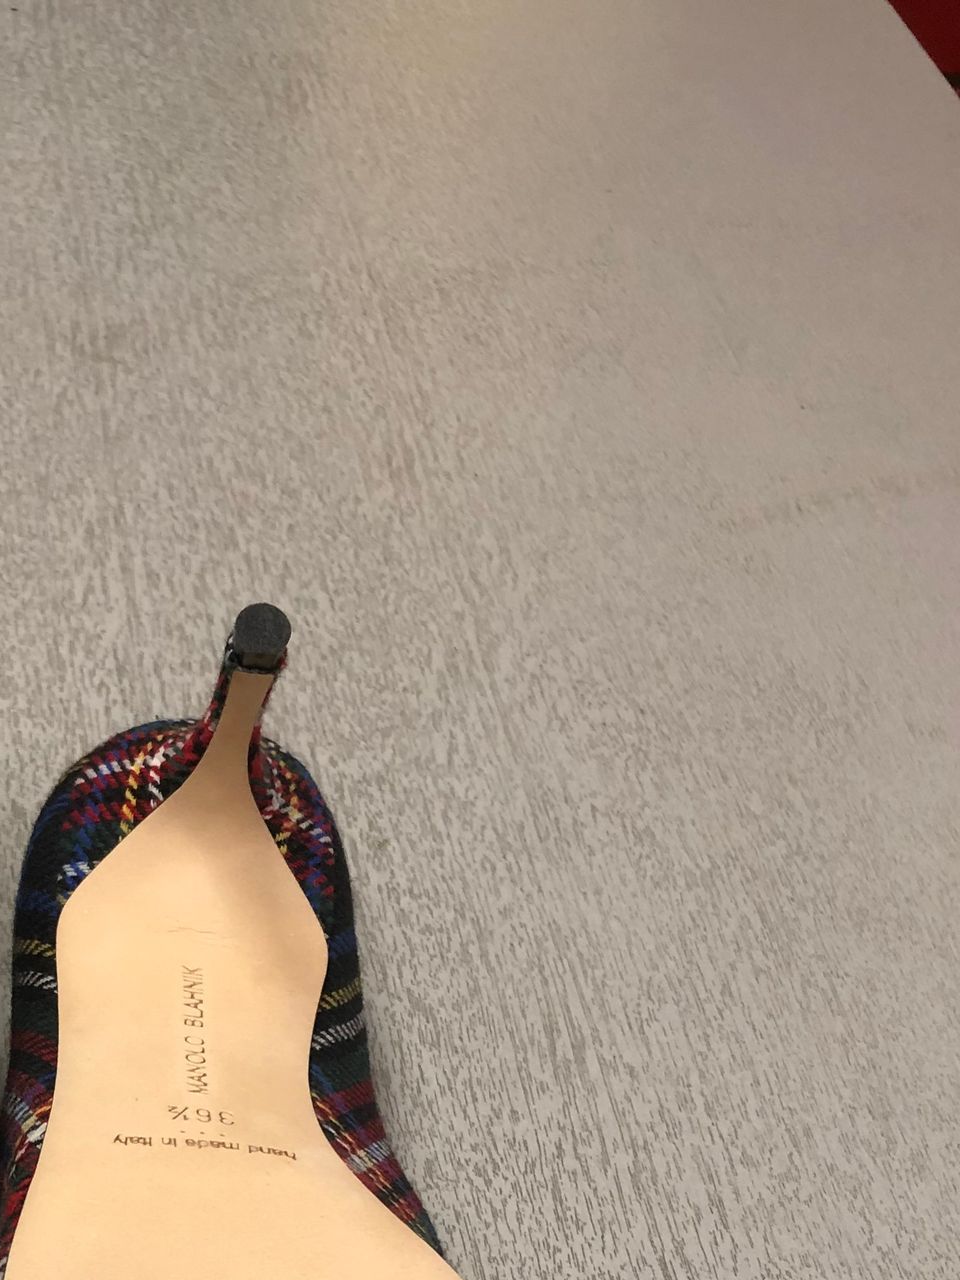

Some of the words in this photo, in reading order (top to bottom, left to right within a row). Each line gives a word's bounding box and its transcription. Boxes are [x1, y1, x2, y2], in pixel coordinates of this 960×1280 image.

[181, 964, 204, 1028] BLAHNIK
[185, 1035, 208, 1095] MANOLO
[113, 1134, 153, 1147] Italy
[185, 1137, 240, 1151] made
[248, 1144, 297, 1161] hand
